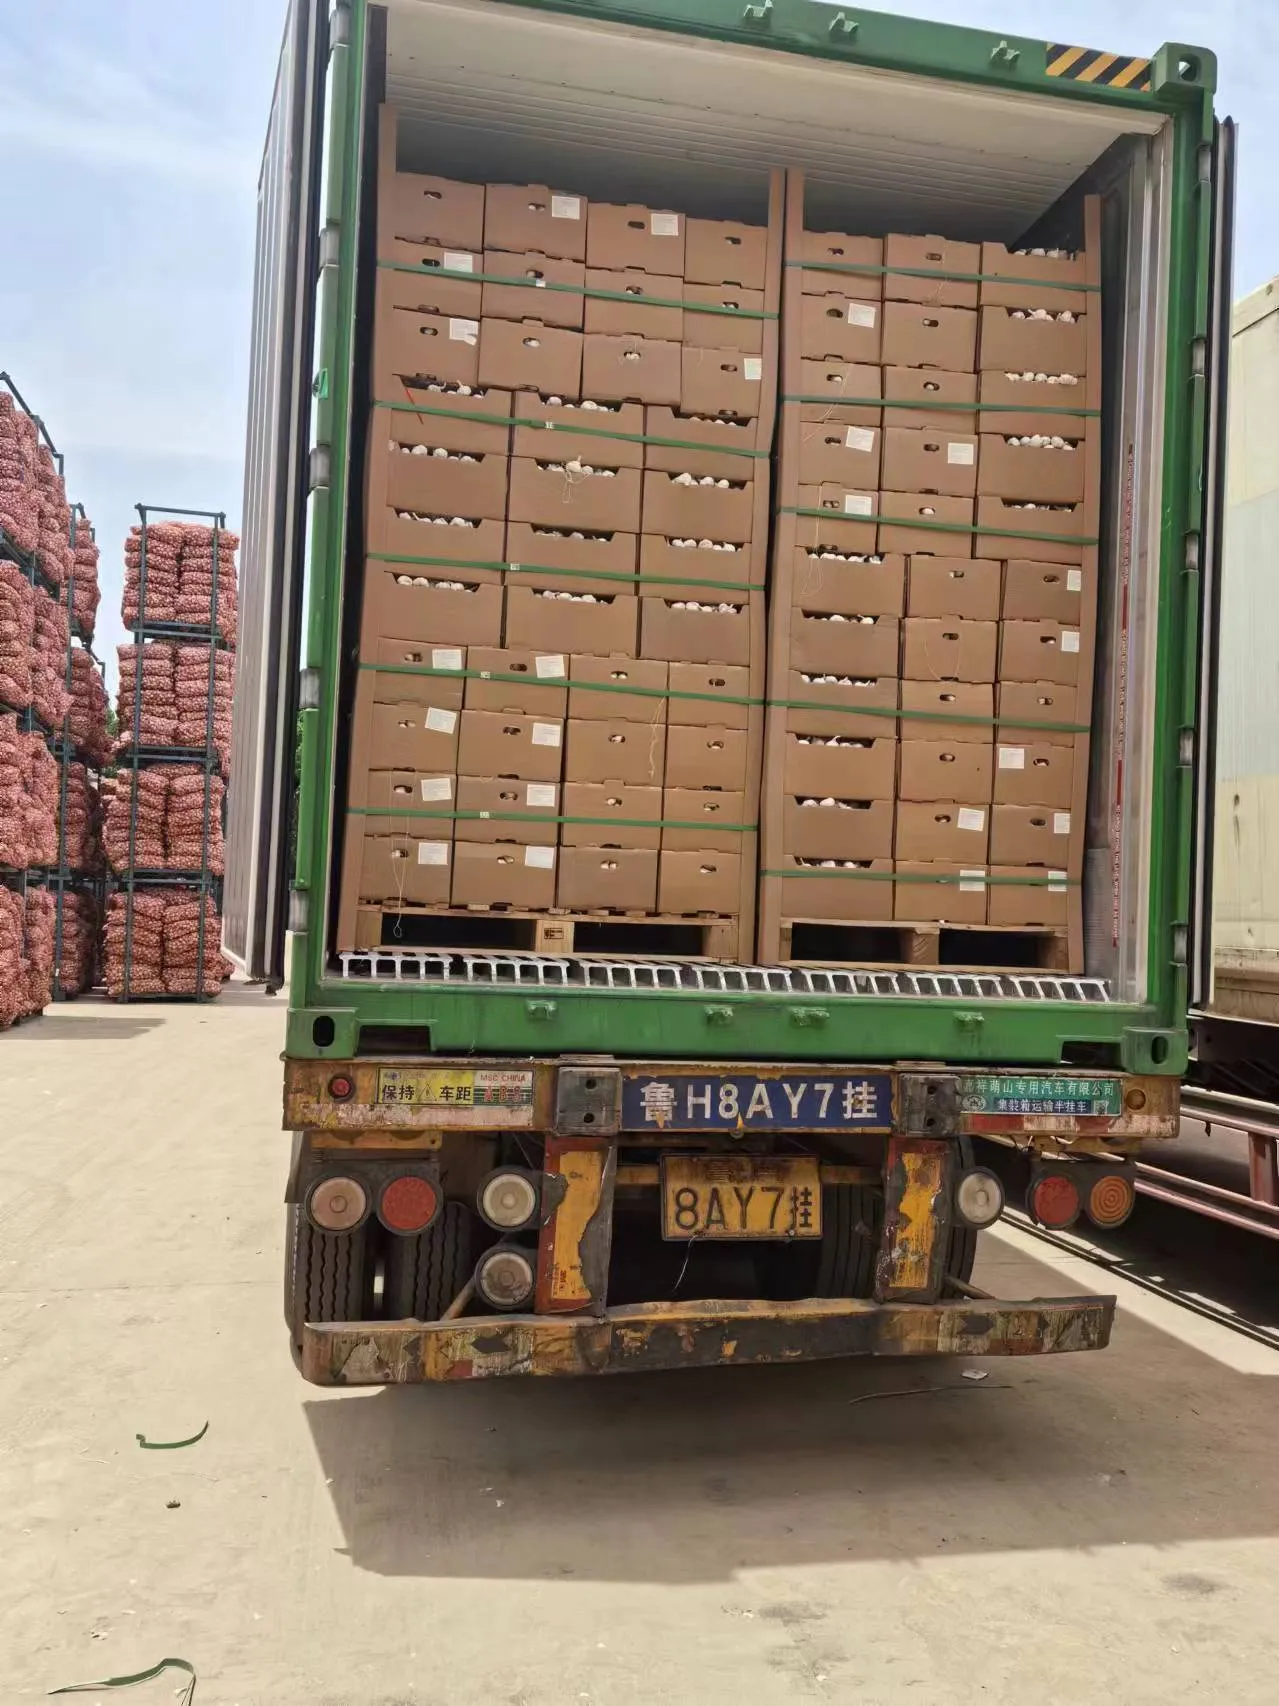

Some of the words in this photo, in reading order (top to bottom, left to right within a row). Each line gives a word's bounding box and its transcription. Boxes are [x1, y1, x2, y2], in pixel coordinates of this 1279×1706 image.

[382, 1084, 415, 1101] 保持
[439, 1086, 473, 1101] 车距
[501, 1074, 526, 1083] CHINA
[640, 1081, 878, 1122] 鲁H8AY7挂
[675, 1186, 813, 1231] 8AY7挂
